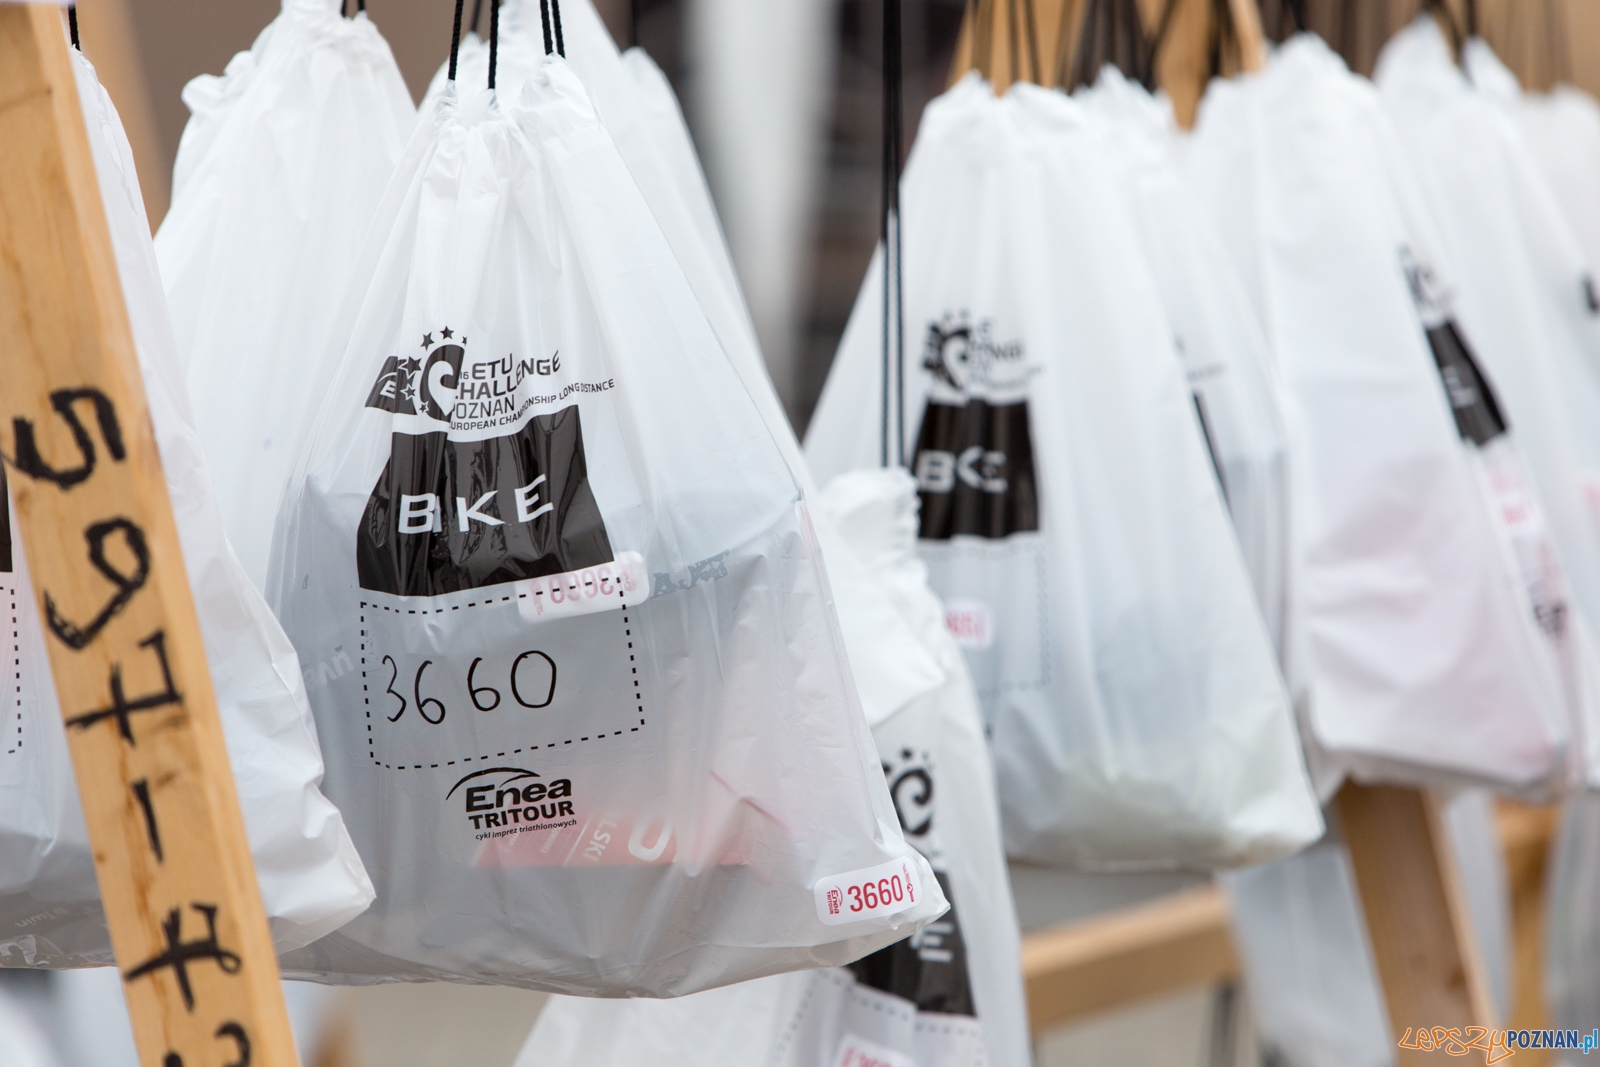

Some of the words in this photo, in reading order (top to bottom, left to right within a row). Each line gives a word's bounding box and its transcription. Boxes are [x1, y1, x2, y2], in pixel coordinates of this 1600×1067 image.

[455, 349, 561, 401] HALLENGE
[471, 352, 514, 380] ETU
[449, 418, 497, 431] UROPEAN
[558, 382, 580, 400] LONG
[452, 394, 515, 420] OZNAN
[398, 473, 555, 535] BIKE
[382, 650, 557, 725] 3660
[466, 778, 572, 812] Enea
[468, 800, 576, 830] TRITOUR
[475, 832, 491, 841] cykl
[492, 828, 518, 839] imprez
[519, 819, 577, 833] triathlonowych
[831, 889, 840, 914] Enea
[847, 874, 904, 913] 3660
